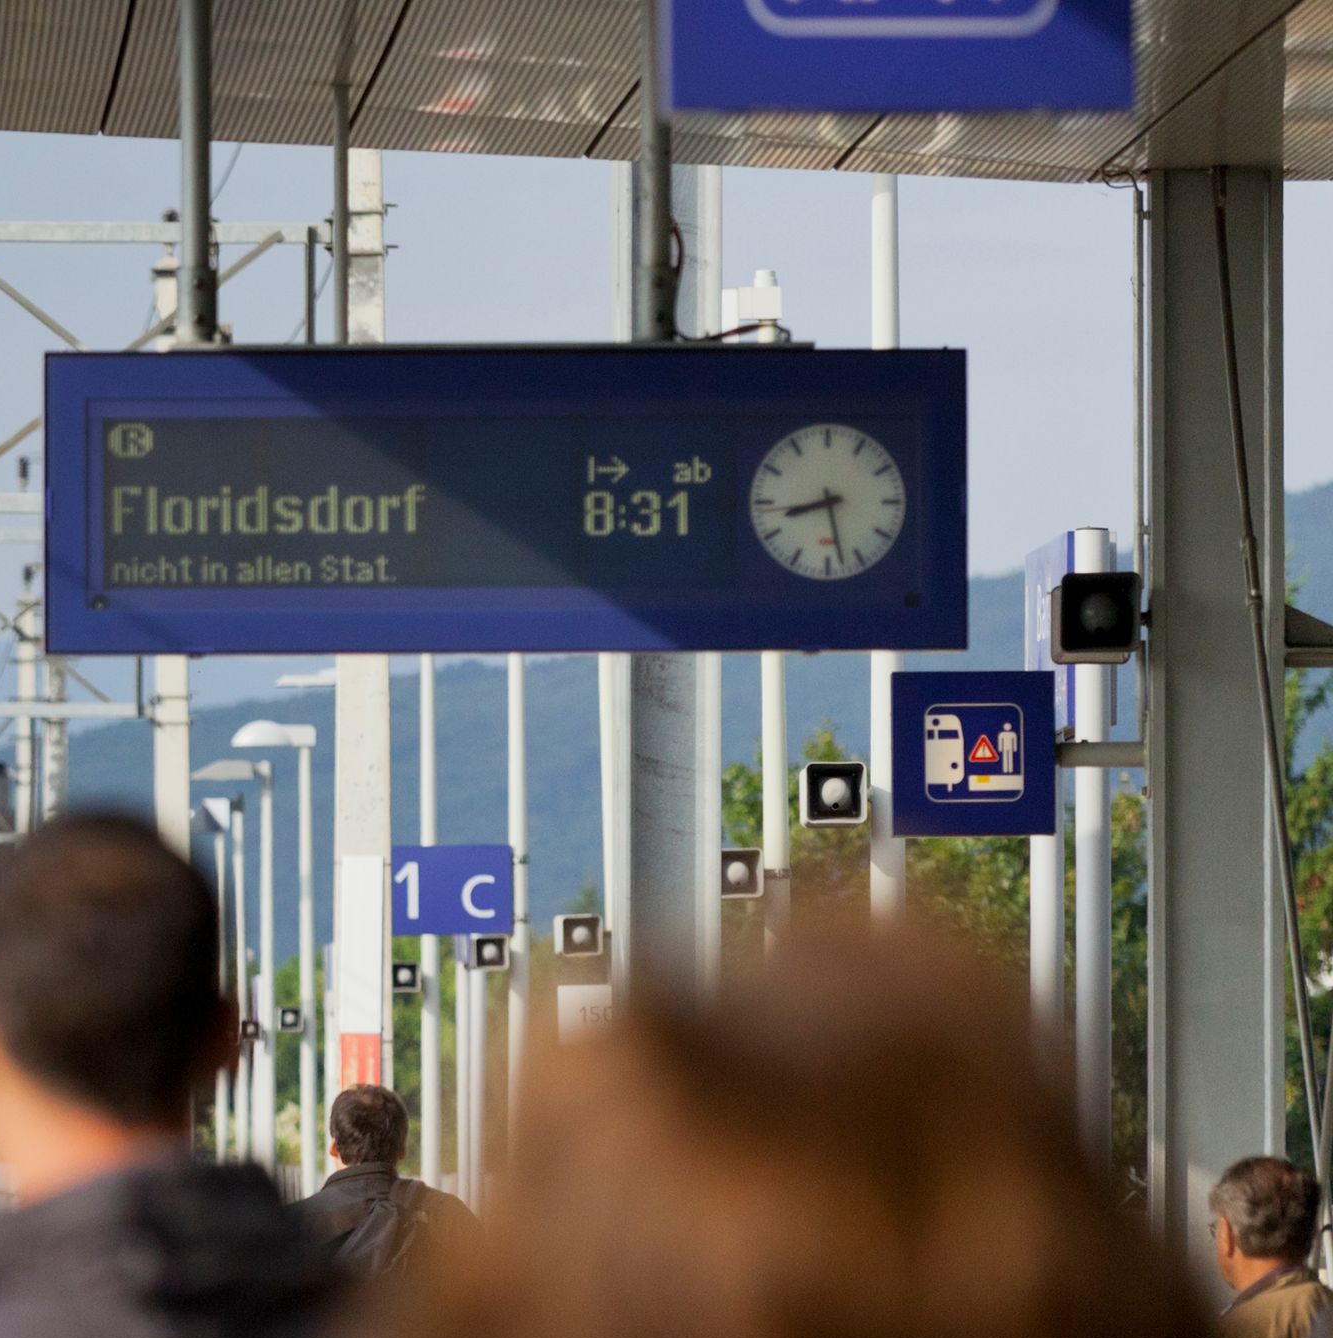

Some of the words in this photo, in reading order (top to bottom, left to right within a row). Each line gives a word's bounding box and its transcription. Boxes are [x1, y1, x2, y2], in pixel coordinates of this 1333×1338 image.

[673, 456, 712, 483] ab
[113, 484, 425, 535] Floridsdorf
[585, 491, 689, 536] 8:31
[112, 556, 192, 583] nicht
[202, 556, 228, 583] in
[237, 556, 311, 583] allen
[320, 556, 397, 583] Stat.
[394, 861, 419, 920] 1
